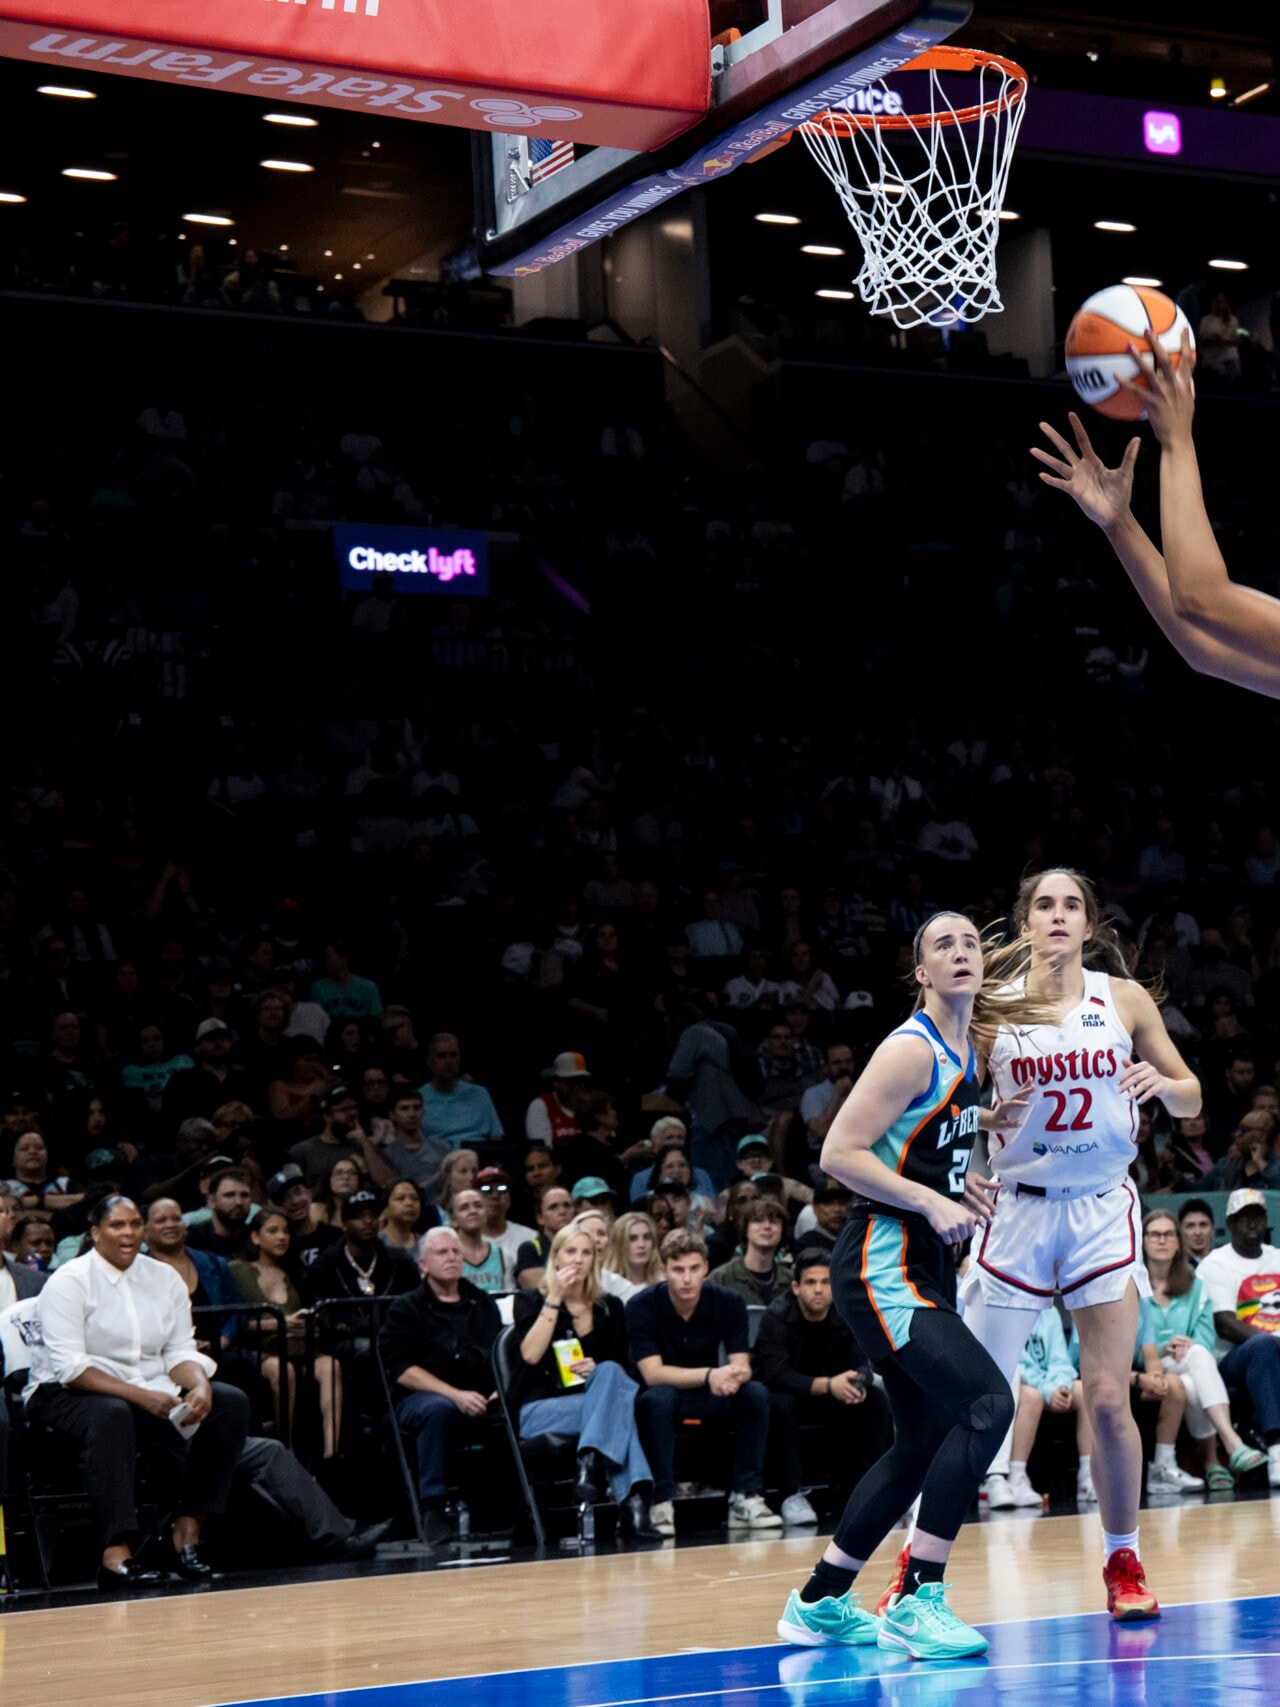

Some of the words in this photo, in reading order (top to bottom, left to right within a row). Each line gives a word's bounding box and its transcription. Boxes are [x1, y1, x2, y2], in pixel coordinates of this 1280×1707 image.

[813, 81, 851, 102] YOU
[349, 546, 428, 574] Check
[428, 547, 476, 581] lyft
[1010, 1047, 1117, 1087] mystics
[1043, 1087, 1093, 1132] 22
[1048, 1141, 1099, 1155] VANDA
[947, 1148, 974, 1194] 2
